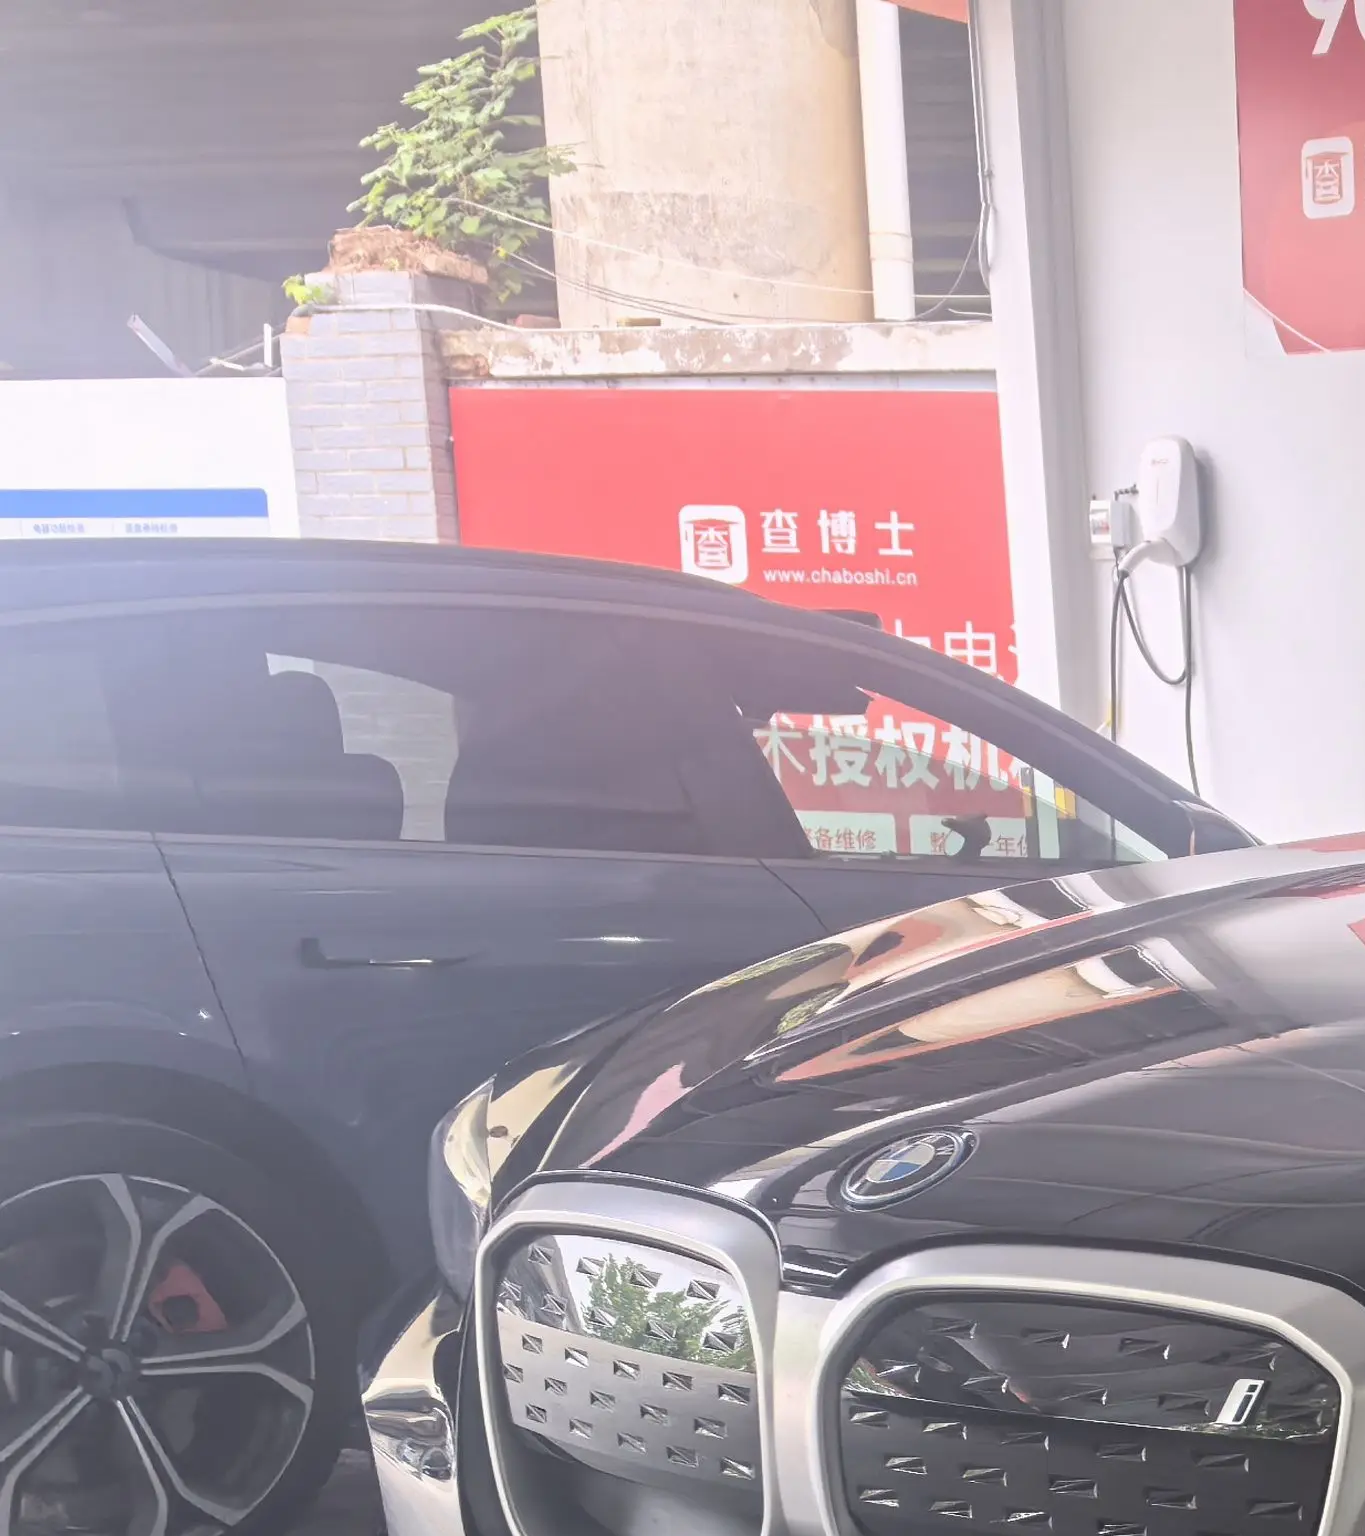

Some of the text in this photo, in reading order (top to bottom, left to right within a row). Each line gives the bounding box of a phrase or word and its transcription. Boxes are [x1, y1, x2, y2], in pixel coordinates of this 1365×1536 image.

[763, 568, 918, 586] www.chaboshi.cn
[753, 712, 1021, 791] 术授权机
